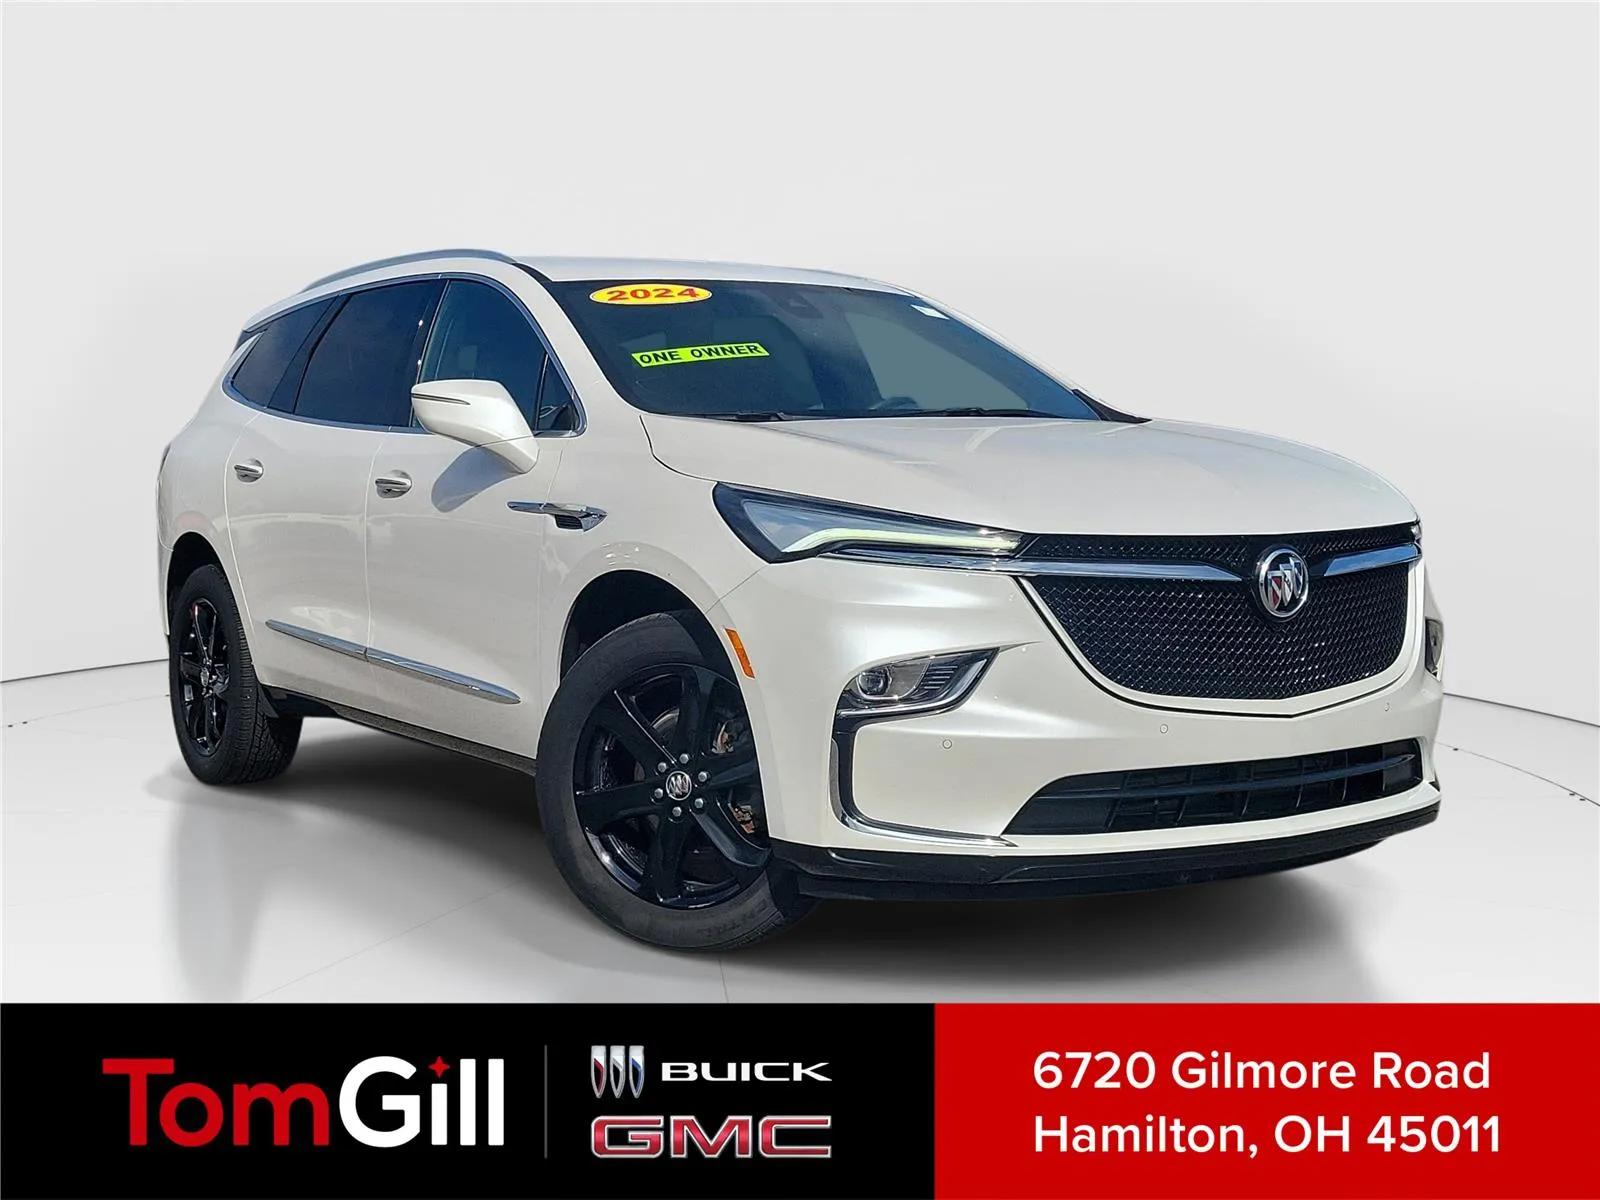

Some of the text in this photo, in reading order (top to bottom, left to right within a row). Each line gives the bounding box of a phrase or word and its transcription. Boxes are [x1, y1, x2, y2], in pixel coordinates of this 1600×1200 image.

[606, 287, 699, 301] 2024
[639, 344, 762, 364] ONE OWNER
